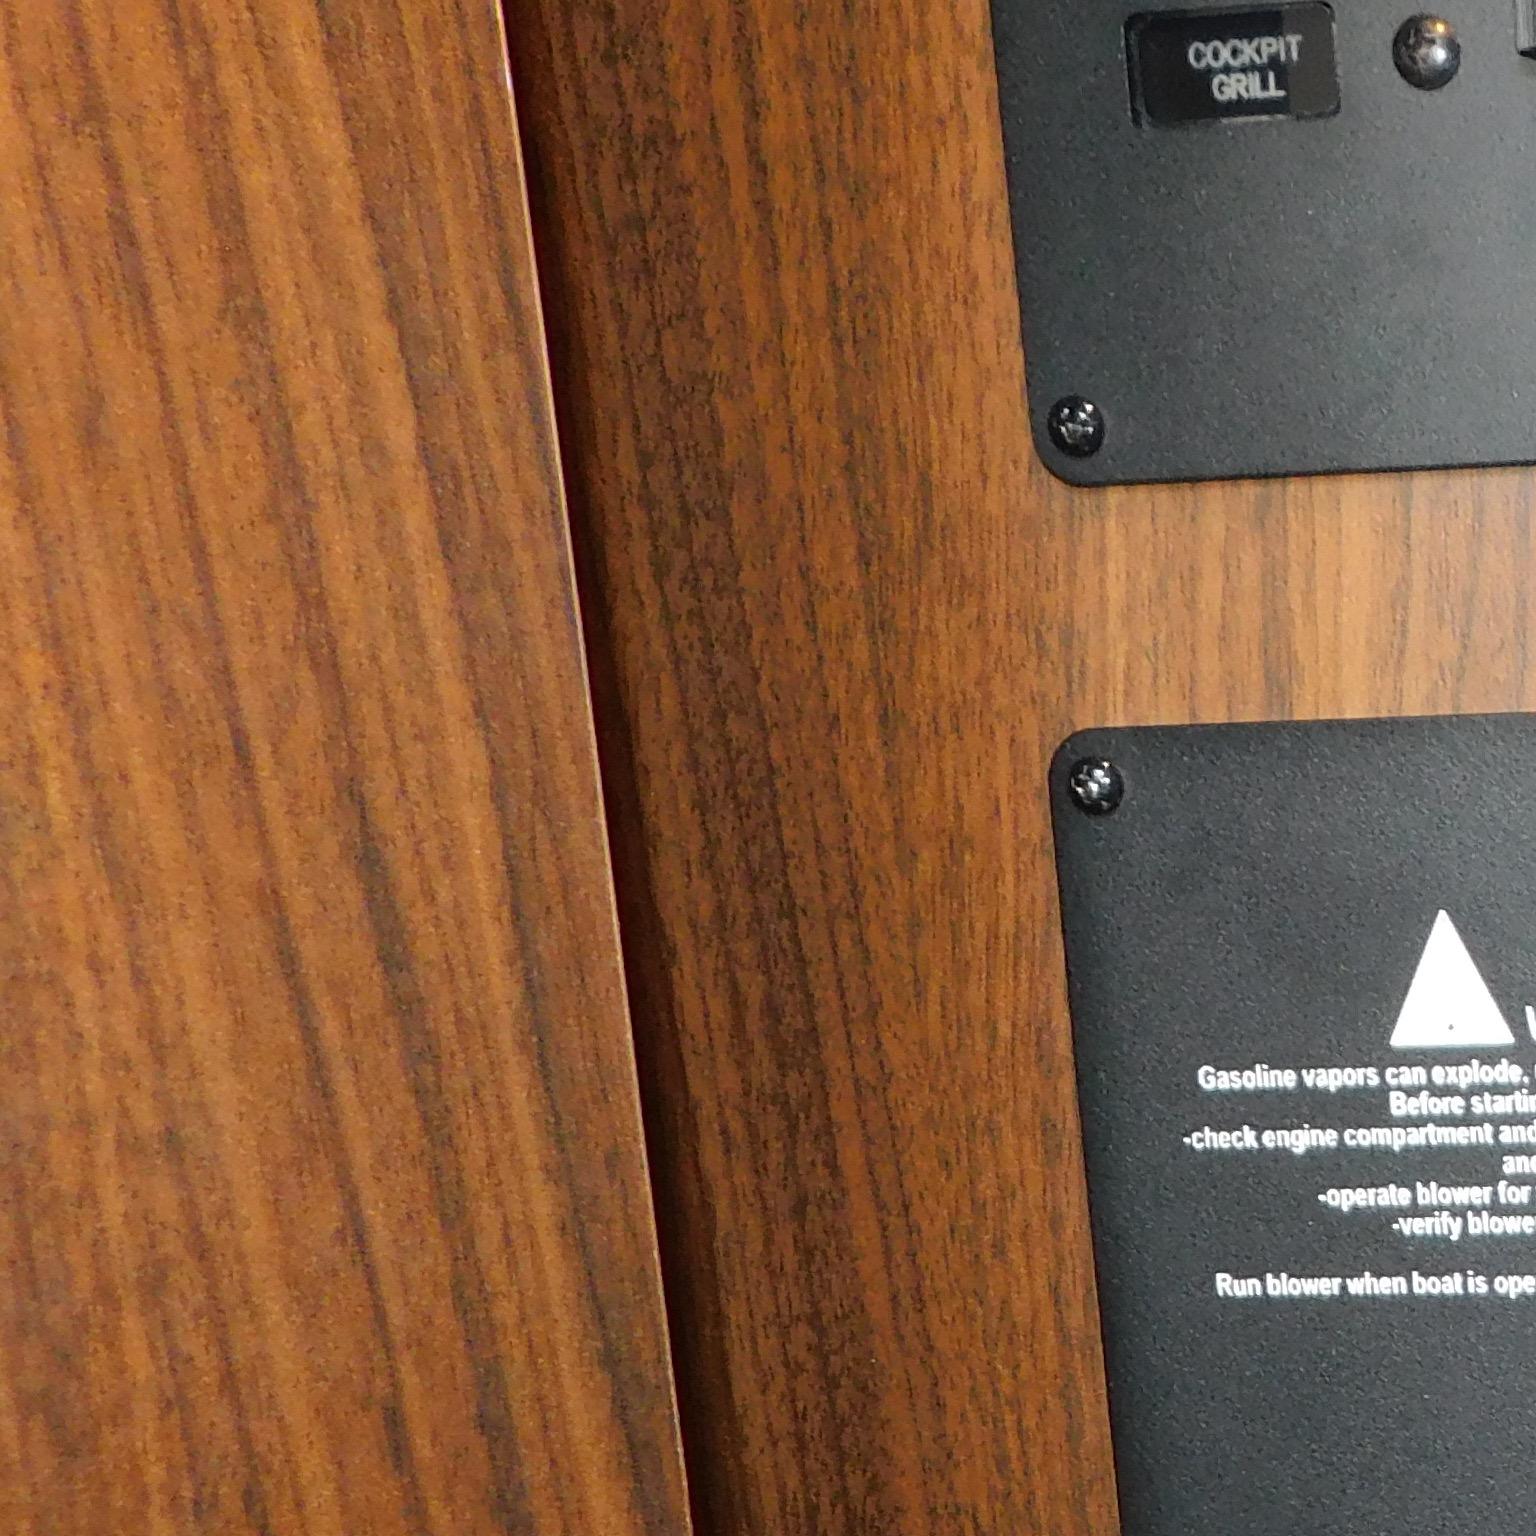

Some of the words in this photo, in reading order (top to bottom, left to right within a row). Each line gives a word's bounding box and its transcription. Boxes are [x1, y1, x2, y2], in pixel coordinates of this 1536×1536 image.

[1188, 34, 1302, 69] COCKPIT
[1211, 70, 1287, 103] GRILL
[1197, 1063, 1298, 1092] Gasoline
[1301, 1066, 1381, 1093] vapors
[1384, 1065, 1428, 1088] can
[1389, 1089, 1466, 1117] Before
[1182, 1124, 1260, 1151] -check
[1261, 1123, 1339, 1155] engine
[1343, 1122, 1495, 1153] compartment
[1317, 1183, 1413, 1212] -operate
[1415, 1181, 1494, 1207] blower
[1496, 1179, 1532, 1206] for
[1392, 1210, 1463, 1242] -verify
[1215, 1272, 1264, 1298] Run
[1265, 1272, 1343, 1297] blower
[1345, 1271, 1409, 1297] when
[1411, 1270, 1465, 1296] boat
[1466, 1269, 1490, 1295] is
